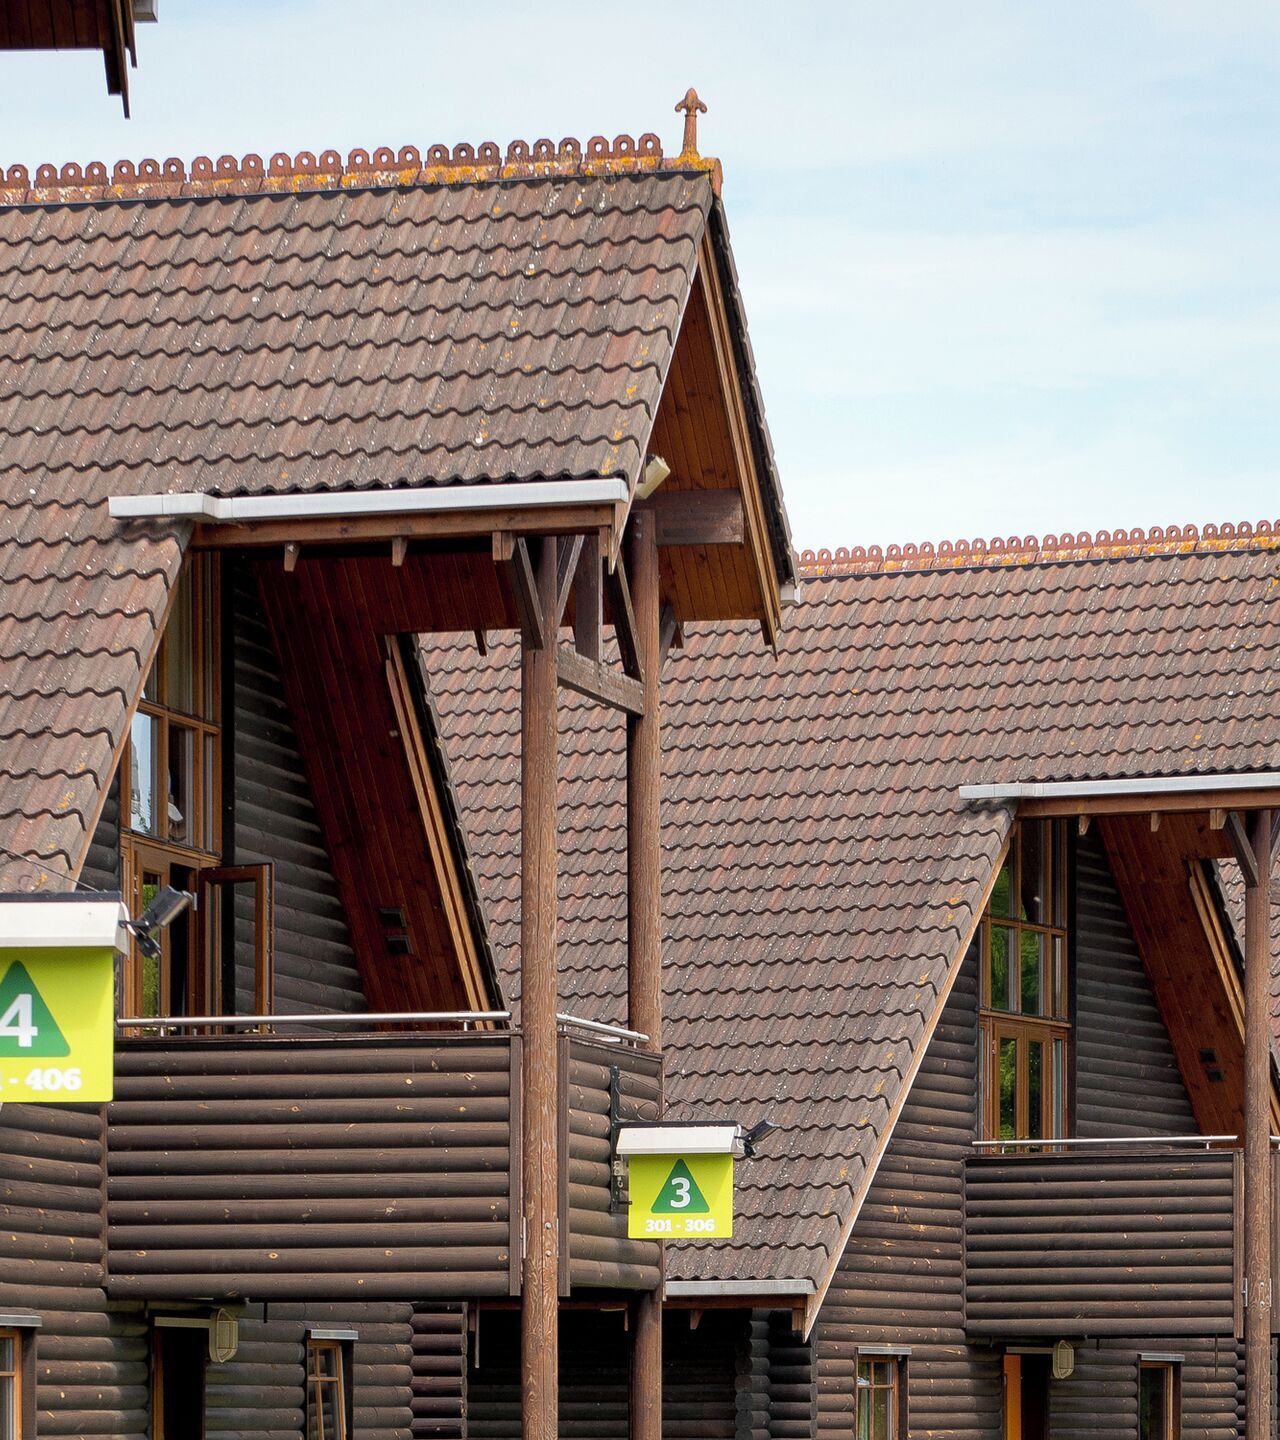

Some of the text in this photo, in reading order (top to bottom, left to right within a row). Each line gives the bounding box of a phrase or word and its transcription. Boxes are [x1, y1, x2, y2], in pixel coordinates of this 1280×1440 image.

[24, 1068, 82, 1091] 406
[670, 1177, 691, 1208] 3
[644, 1219, 672, 1232] 301
[684, 1219, 715, 1232] 306
